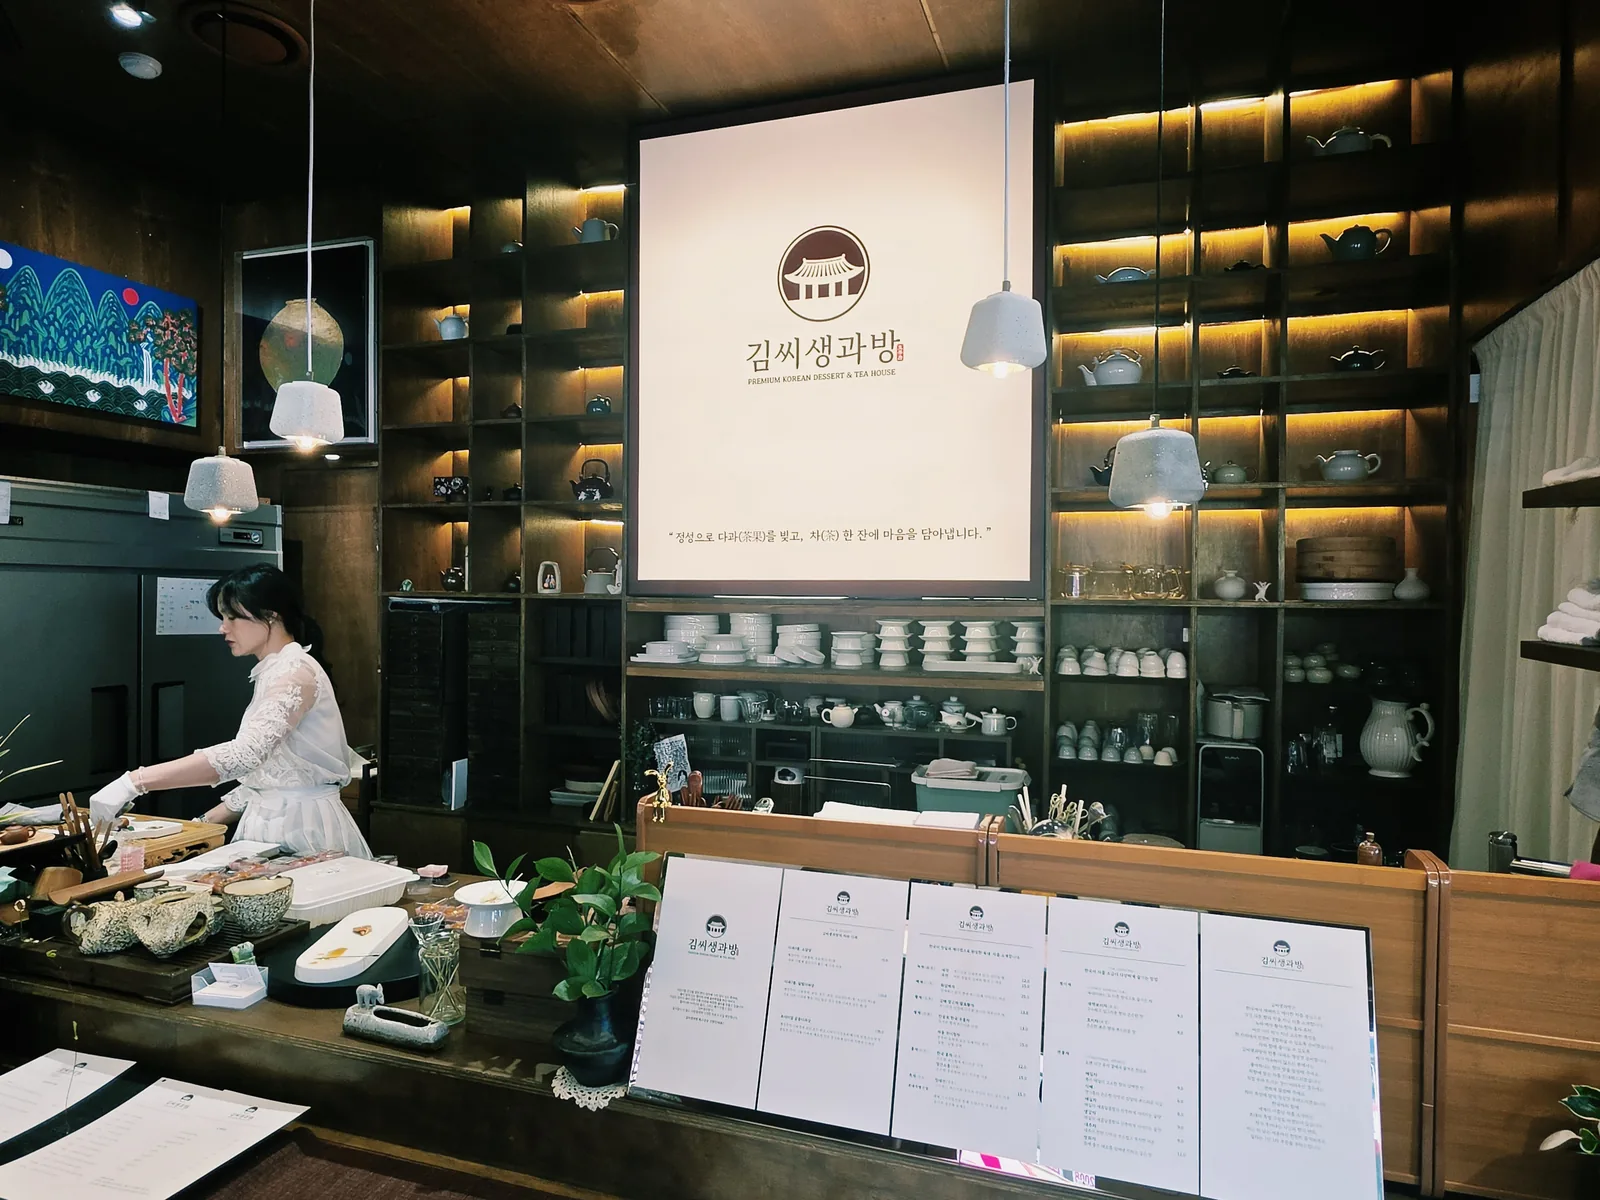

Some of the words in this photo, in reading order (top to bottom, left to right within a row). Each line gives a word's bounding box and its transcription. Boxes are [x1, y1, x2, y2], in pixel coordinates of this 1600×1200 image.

[746, 329, 901, 372] 김씨생과방
[747, 377, 781, 385] PREMIUM
[782, 374, 812, 383] KOREAN
[813, 372, 845, 380] DESSERT
[854, 370, 869, 378] TEA
[870, 368, 896, 376] HOUSE
[842, 528, 854, 541] 한
[857, 528, 879, 541] 잔에
[883, 527, 918, 541] 마음을
[688, 938, 739, 956] 김씨생과방
